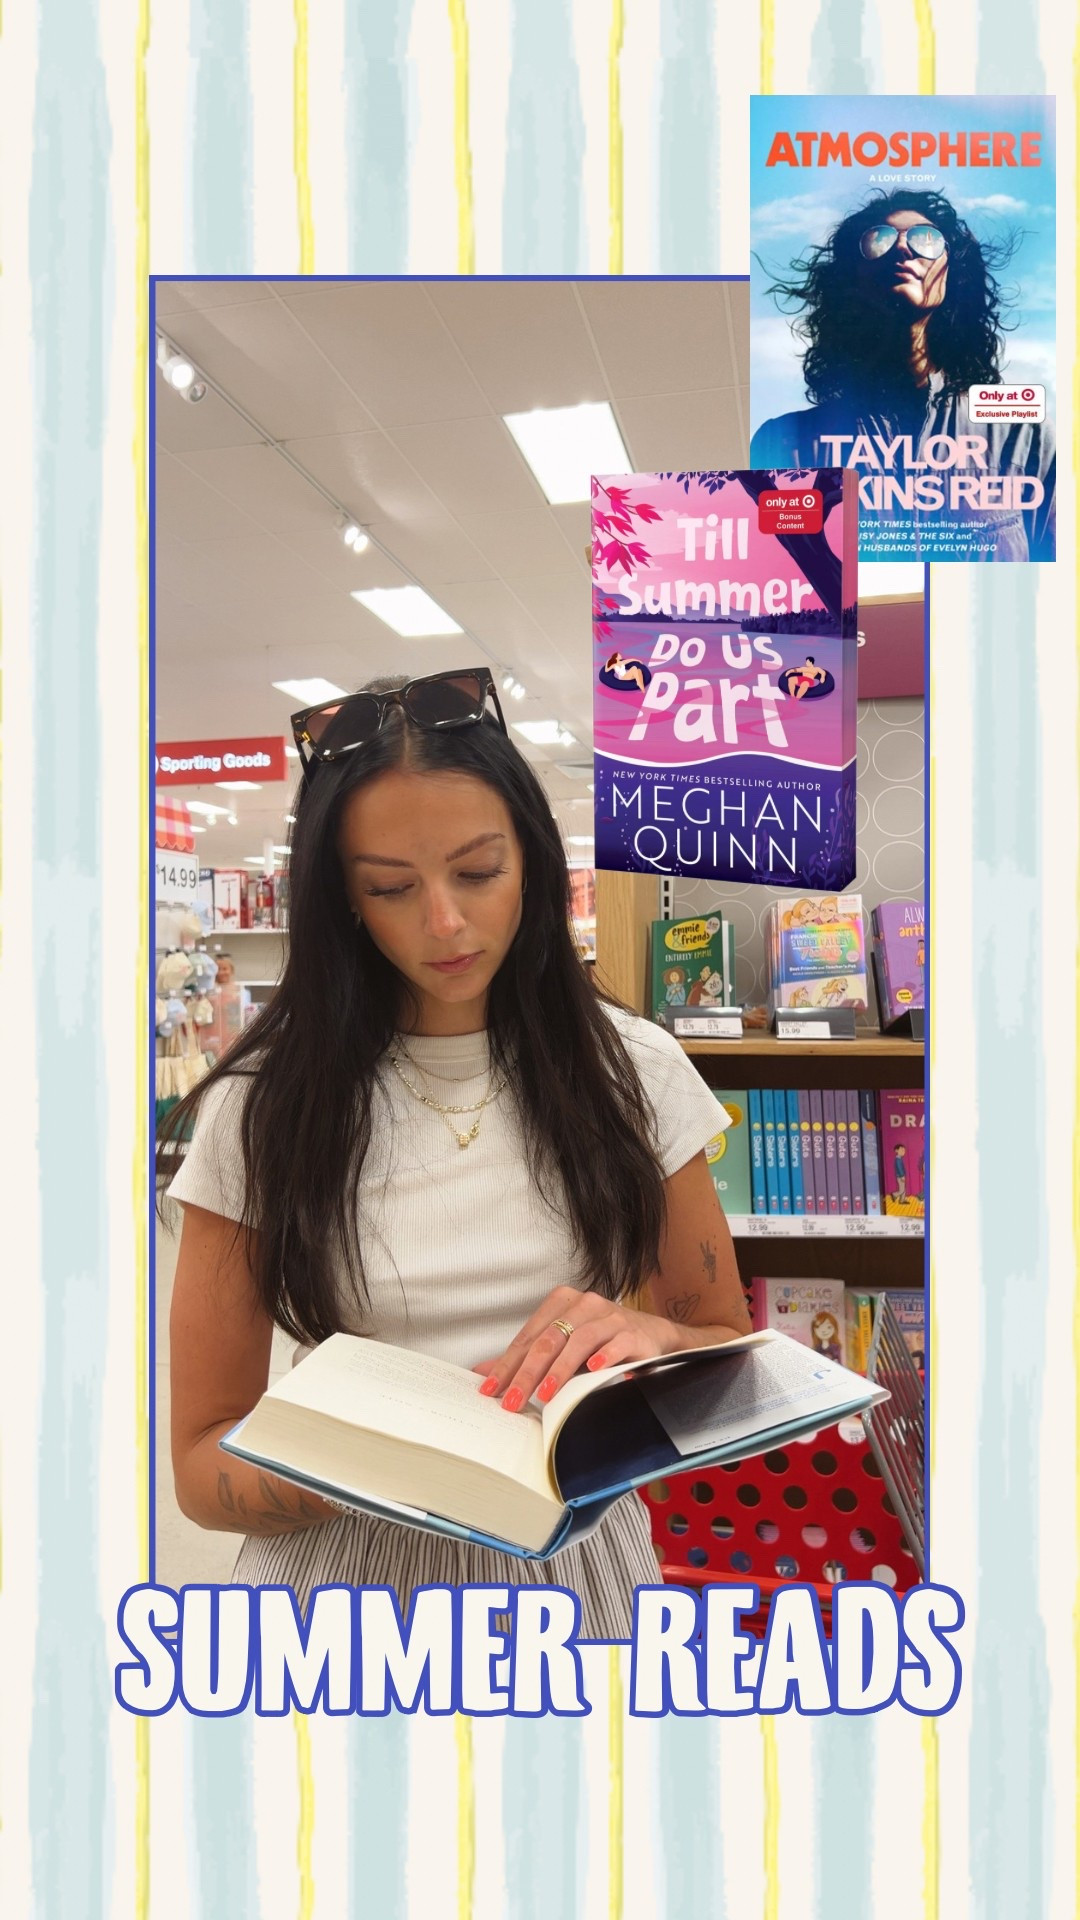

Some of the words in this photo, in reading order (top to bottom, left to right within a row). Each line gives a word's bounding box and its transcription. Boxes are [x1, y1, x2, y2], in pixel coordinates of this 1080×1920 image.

[765, 131, 1042, 168] ATMOSPHERE
[878, 174, 902, 182] LOVE
[904, 174, 937, 182] STORY
[979, 390, 1004, 402] Only
[1006, 391, 1018, 401] at
[976, 410, 1010, 419] Exclusive
[1011, 410, 1038, 420] Playlist
[820, 434, 988, 470] TAYLOR
[765, 498, 788, 508] only
[789, 497, 800, 507] at
[951, 475, 1045, 511] REID
[776, 521, 805, 530] Content
[779, 512, 802, 521] Bonus
[858, 520, 881, 529] ORK
[883, 520, 912, 529] TIMES
[912, 520, 959, 530] bestselling
[960, 520, 988, 529] author
[677, 513, 750, 562] Till
[863, 543, 917, 552] HUSBANDS
[919, 544, 934, 552] OF
[933, 544, 968, 552] EVELYN
[969, 544, 998, 552] HUGO
[876, 532, 908, 540] JONES
[909, 532, 916, 540] &
[918, 532, 937, 540] THE
[938, 532, 955, 540] SIX
[955, 532, 972, 541] and
[618, 572, 815, 617] Summer
[628, 671, 789, 748] Part
[159, 754, 222, 774] Sporting
[222, 751, 271, 769] Goods
[612, 770, 636, 780] NEW
[638, 771, 668, 782] YORK
[670, 773, 701, 784] TIMES
[704, 776, 774, 789] BESTSELLING
[776, 780, 822, 791] AUTHOR
[612, 782, 822, 833] MEGHAN
[633, 825, 797, 874] QUINN
[672, 923, 700, 936] emmie
[681, 931, 711, 946] friends
[665, 952, 693, 962] ENTIRELY
[693, 949, 712, 960] EMMIE
[753, 1135, 762, 1168] Sisters
[766, 1135, 775, 1168] Sisters
[777, 1135, 786, 1168] Sisters
[791, 1135, 799, 1168] Sisters
[801, 1135, 810, 1159] Guts
[813, 1135, 822, 1159] Guts
[826, 1135, 835, 1159] Guts
[838, 1135, 847, 1159] Guts
[850, 1135, 859, 1159] Guts
